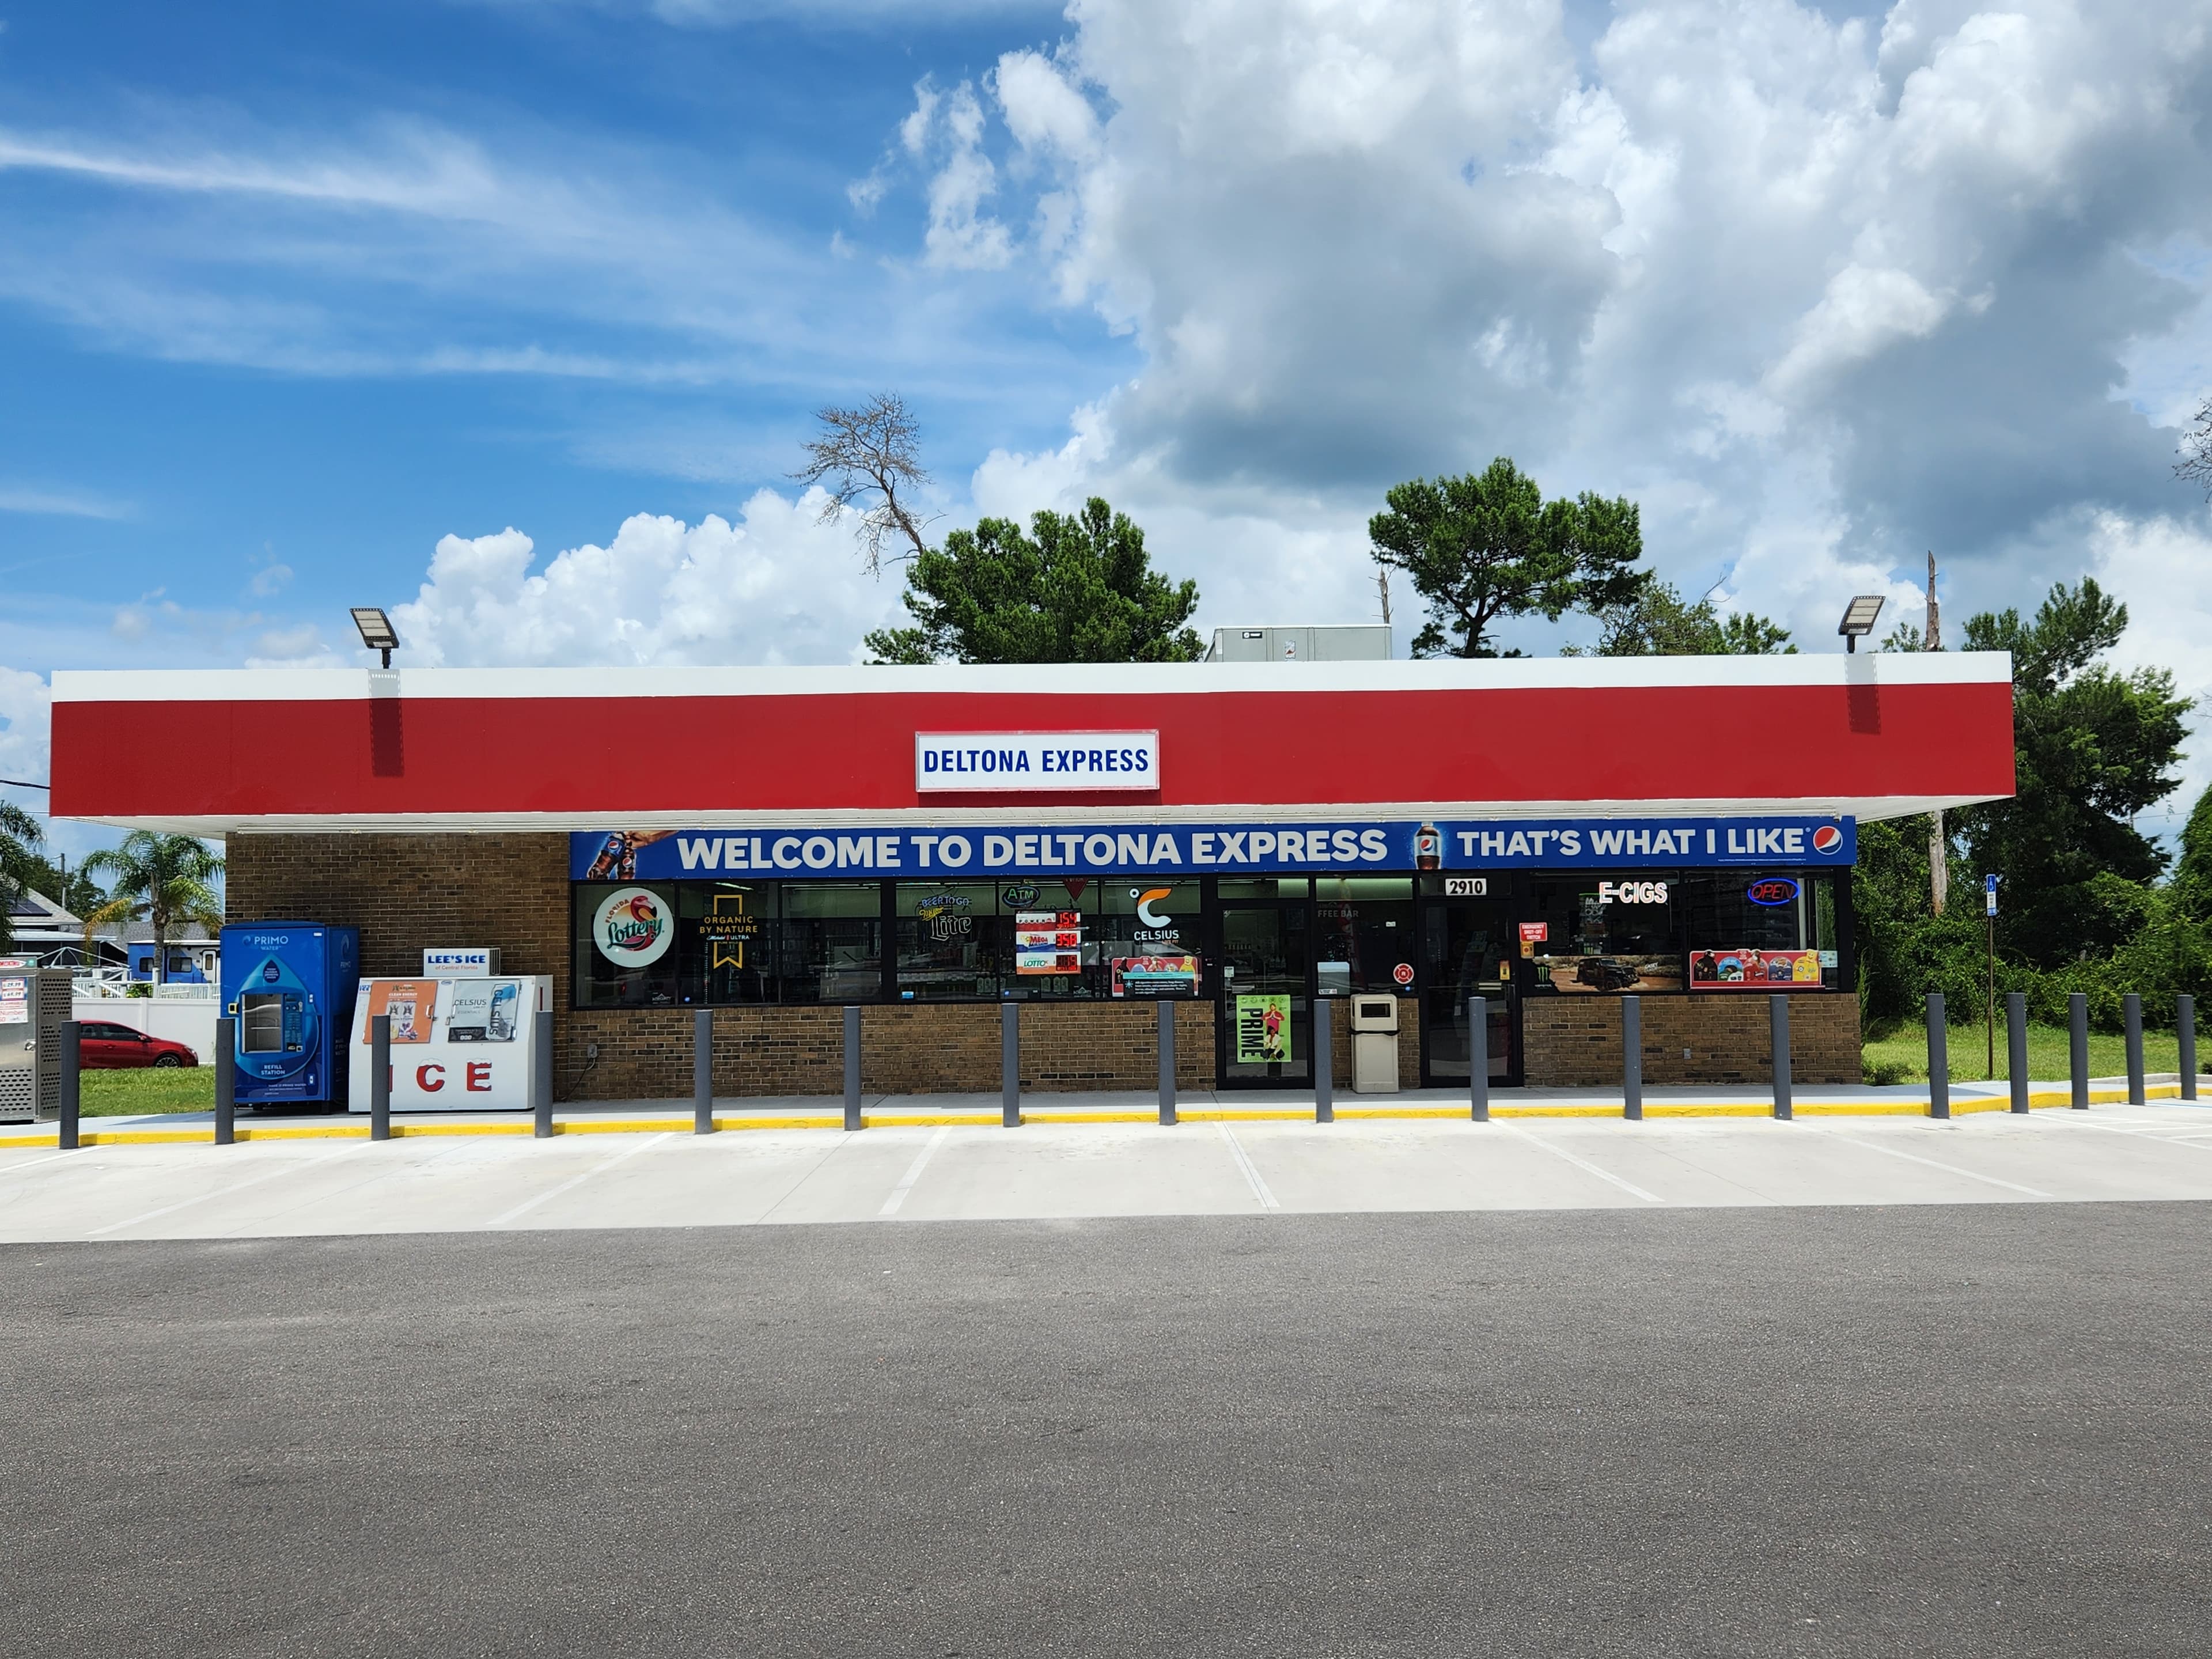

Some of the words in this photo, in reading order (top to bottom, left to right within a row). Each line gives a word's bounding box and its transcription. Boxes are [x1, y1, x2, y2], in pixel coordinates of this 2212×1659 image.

[924, 749, 1030, 772] DELTONA
[1041, 749, 1149, 772] EXPRESS
[677, 836, 901, 869] WELCOME
[911, 836, 972, 867] TO
[984, 834, 1182, 866] DELTONA
[1192, 829, 1387, 864] EXPRESS
[1457, 830, 1581, 856] THAT'S
[1590, 830, 1695, 855] WHAT
[1706, 829, 1715, 854] I
[1728, 828, 1804, 853] LIKE
[1008, 888, 1034, 899] ATM
[1449, 880, 1483, 894] 2910
[1599, 881, 1668, 904] E-CIGS
[1751, 884, 1794, 899] OPEN
[922, 897, 943, 907] BEER
[945, 896, 955, 905] TO
[956, 897, 969, 906] GO
[605, 899, 630, 923] FLORIDA
[704, 916, 753, 924] ORGANIC
[1060, 912, 1077, 925] 154
[607, 918, 664, 949] Lottery
[716, 925, 758, 933] NATURE
[930, 915, 971, 941] Lite
[254, 935, 289, 945] PRIMO
[1056, 934, 1077, 946] 358
[1133, 930, 1179, 941] CELSIUS
[428, 955, 463, 964] LEE'S
[465, 955, 486, 964] ICE
[488, 989, 503, 1035] CELSIUS
[1240, 1008, 1266, 1058] PRIME
